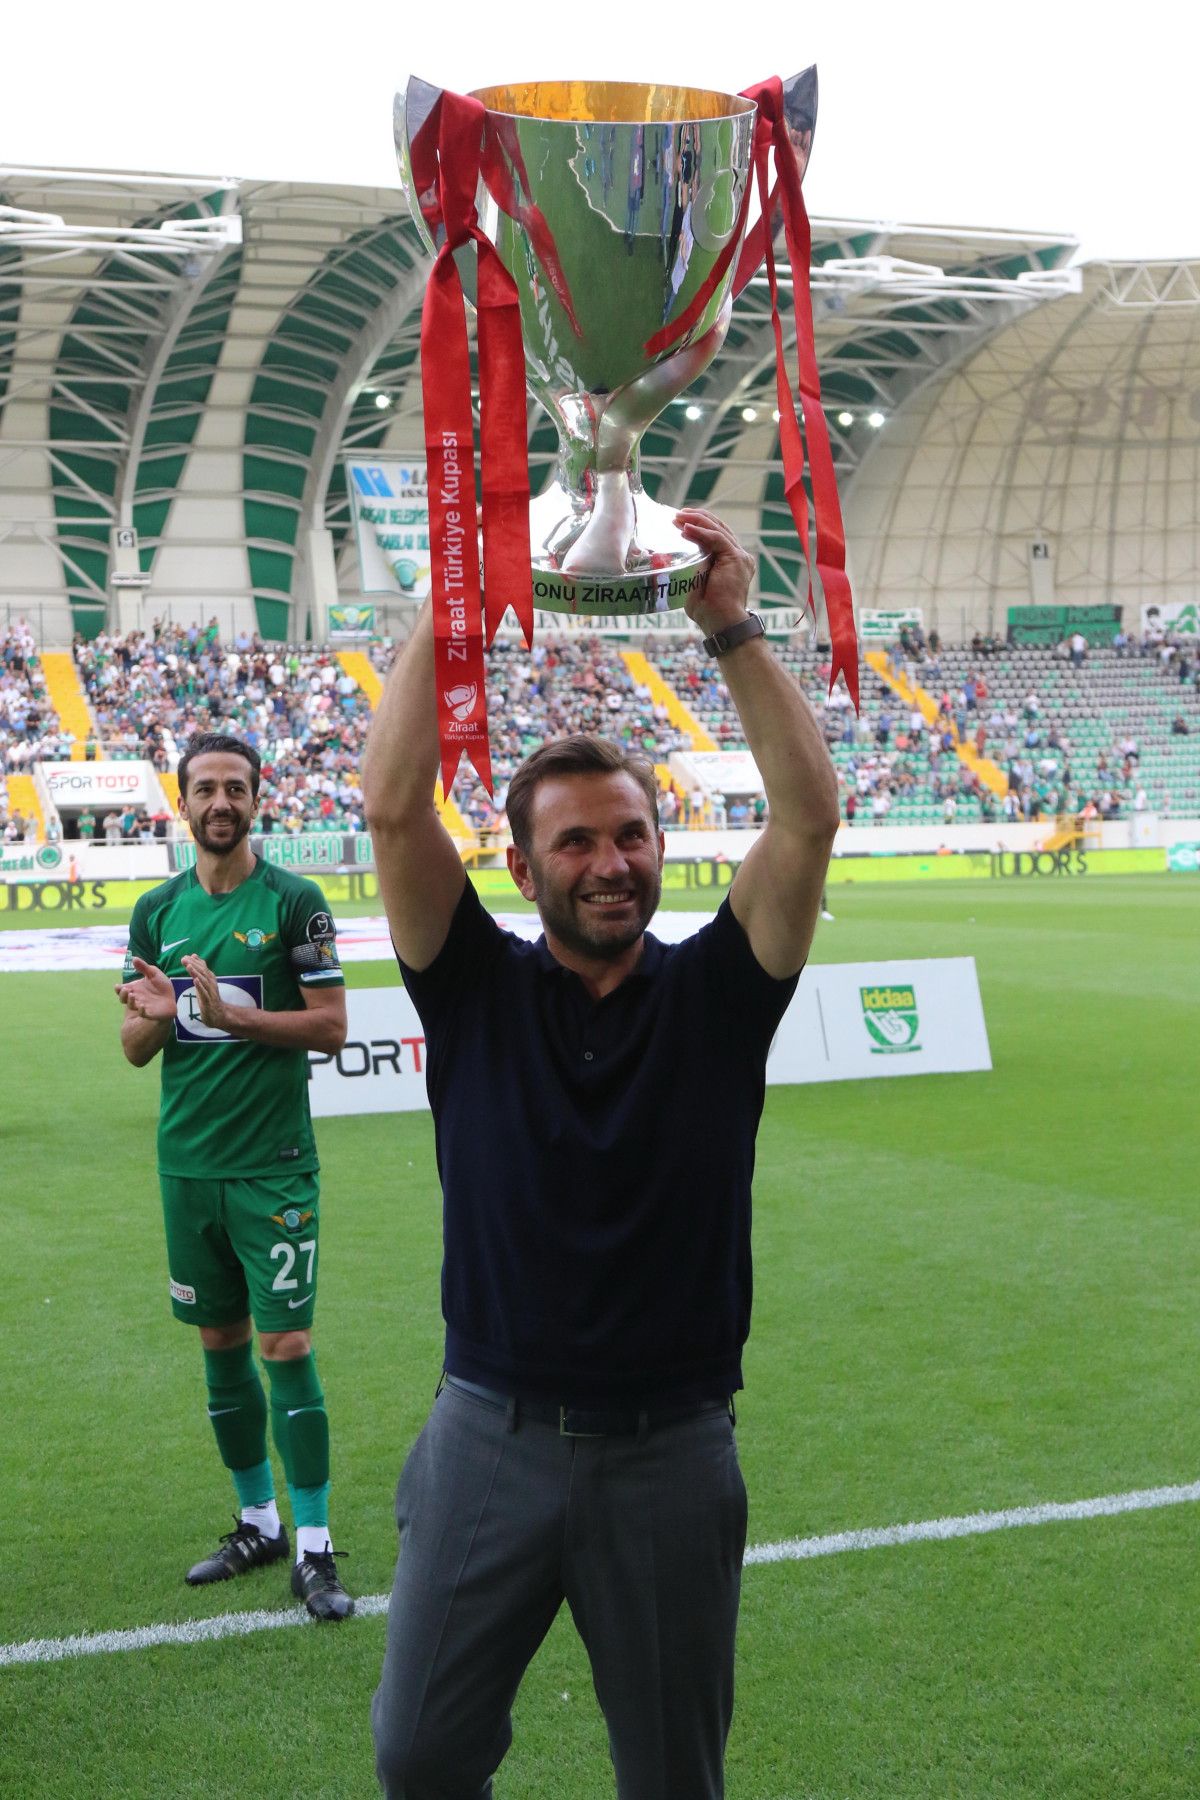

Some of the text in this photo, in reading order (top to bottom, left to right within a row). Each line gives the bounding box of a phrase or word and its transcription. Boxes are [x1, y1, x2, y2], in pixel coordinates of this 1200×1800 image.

[441, 431, 468, 662] Ziraat Türkiye Kupası
[531, 582, 576, 601] ONU
[581, 584, 652, 603] ZİRAAT
[448, 721, 479, 732] Ziraat
[863, 987, 914, 1008] iddaa
[269, 1239, 316, 1291] 27
